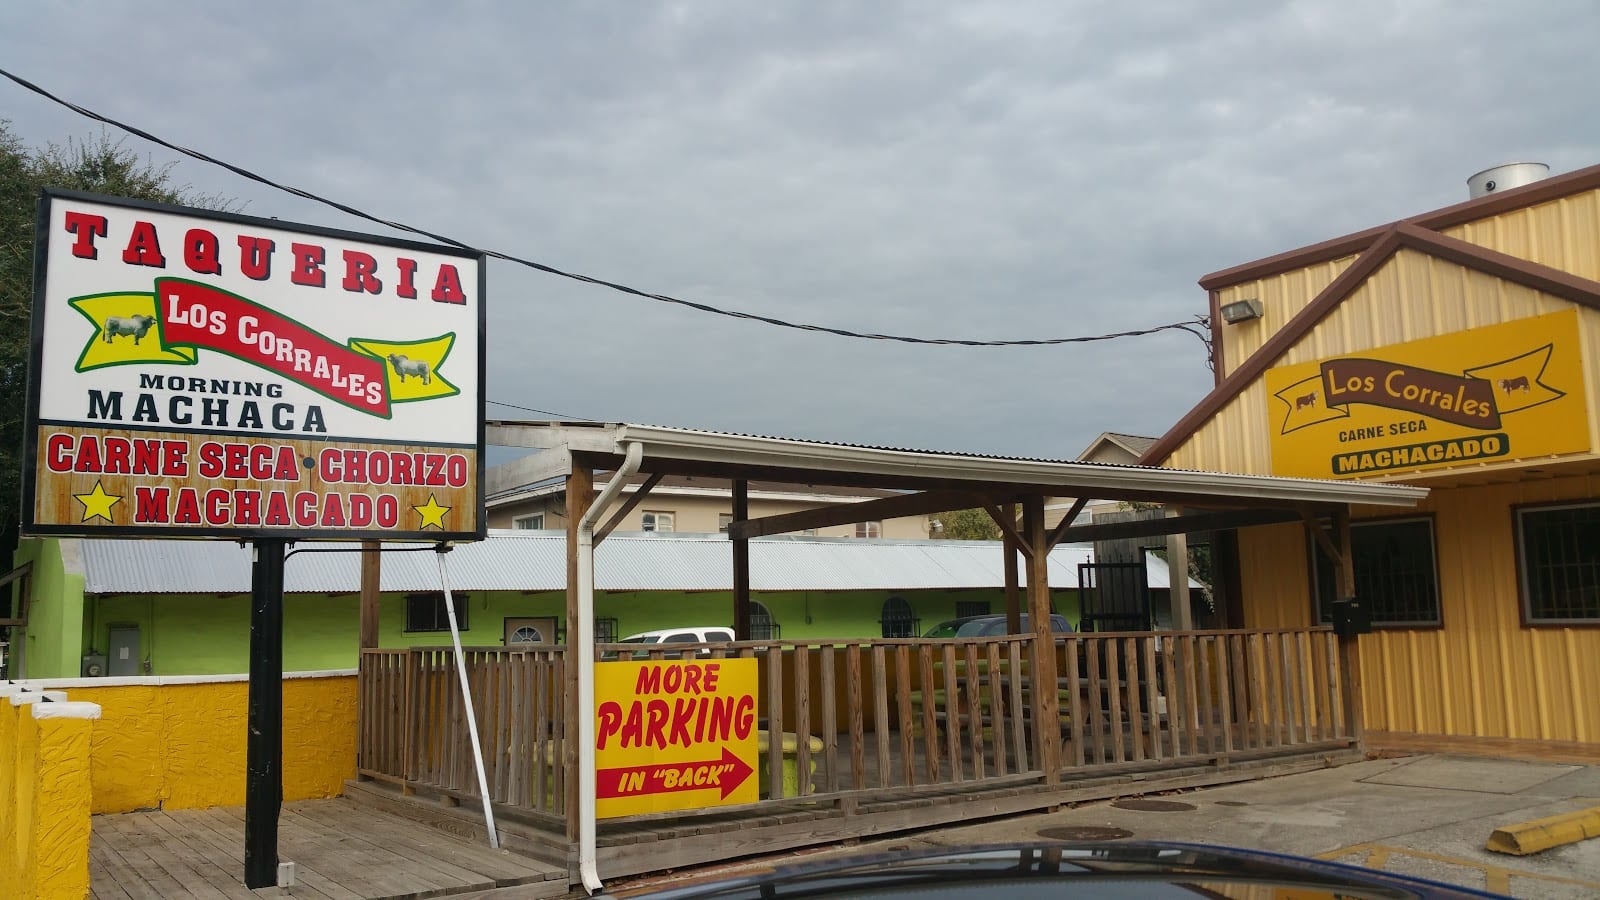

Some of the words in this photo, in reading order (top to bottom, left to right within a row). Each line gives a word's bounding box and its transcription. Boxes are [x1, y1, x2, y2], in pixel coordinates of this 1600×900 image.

[65, 211, 466, 305] TAQUERIA
[168, 295, 227, 335] LOS
[238, 315, 382, 404] CORRALES
[140, 374, 283, 398] MORNING
[1328, 370, 1375, 395] Los
[1385, 371, 1490, 418] Corrales
[88, 390, 327, 433] MACHACA
[1339, 426, 1384, 442] CARNE
[1389, 420, 1427, 435] SECA
[47, 434, 188, 477] CARNE
[199, 442, 300, 482] SECA
[319, 448, 468, 488] CHORIZO
[1339, 437, 1500, 472] MACHACADO
[134, 486, 399, 529] MACHACADO
[635, 664, 720, 695] MORE
[596, 695, 754, 750] PARKING
[617, 771, 646, 793] IN
